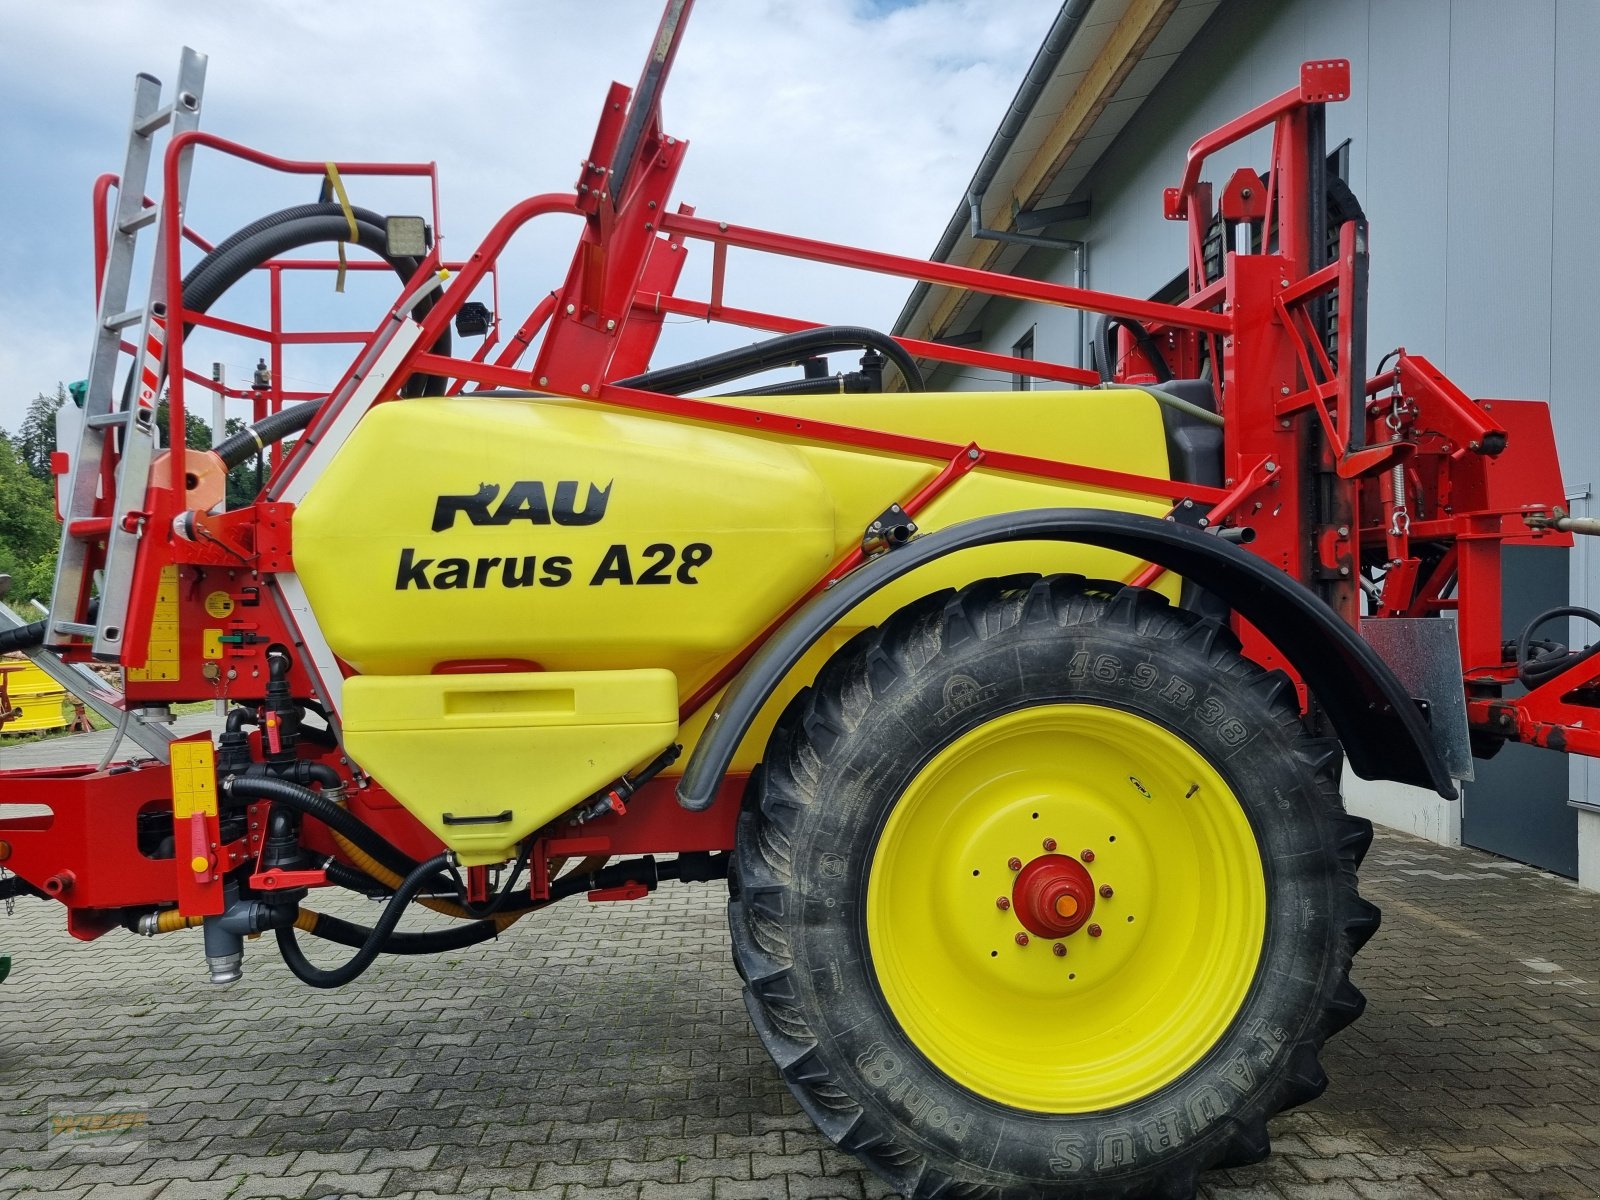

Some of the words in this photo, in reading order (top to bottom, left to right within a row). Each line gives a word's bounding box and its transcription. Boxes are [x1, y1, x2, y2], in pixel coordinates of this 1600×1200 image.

[431, 477, 614, 533] RAU
[395, 548, 574, 590] karus
[589, 543, 713, 586] A28
[1068, 651, 1159, 691] 16.9
[1158, 675, 1196, 710] R
[1195, 697, 1249, 746] 38
[1049, 1018, 1291, 1174] TAURUS
